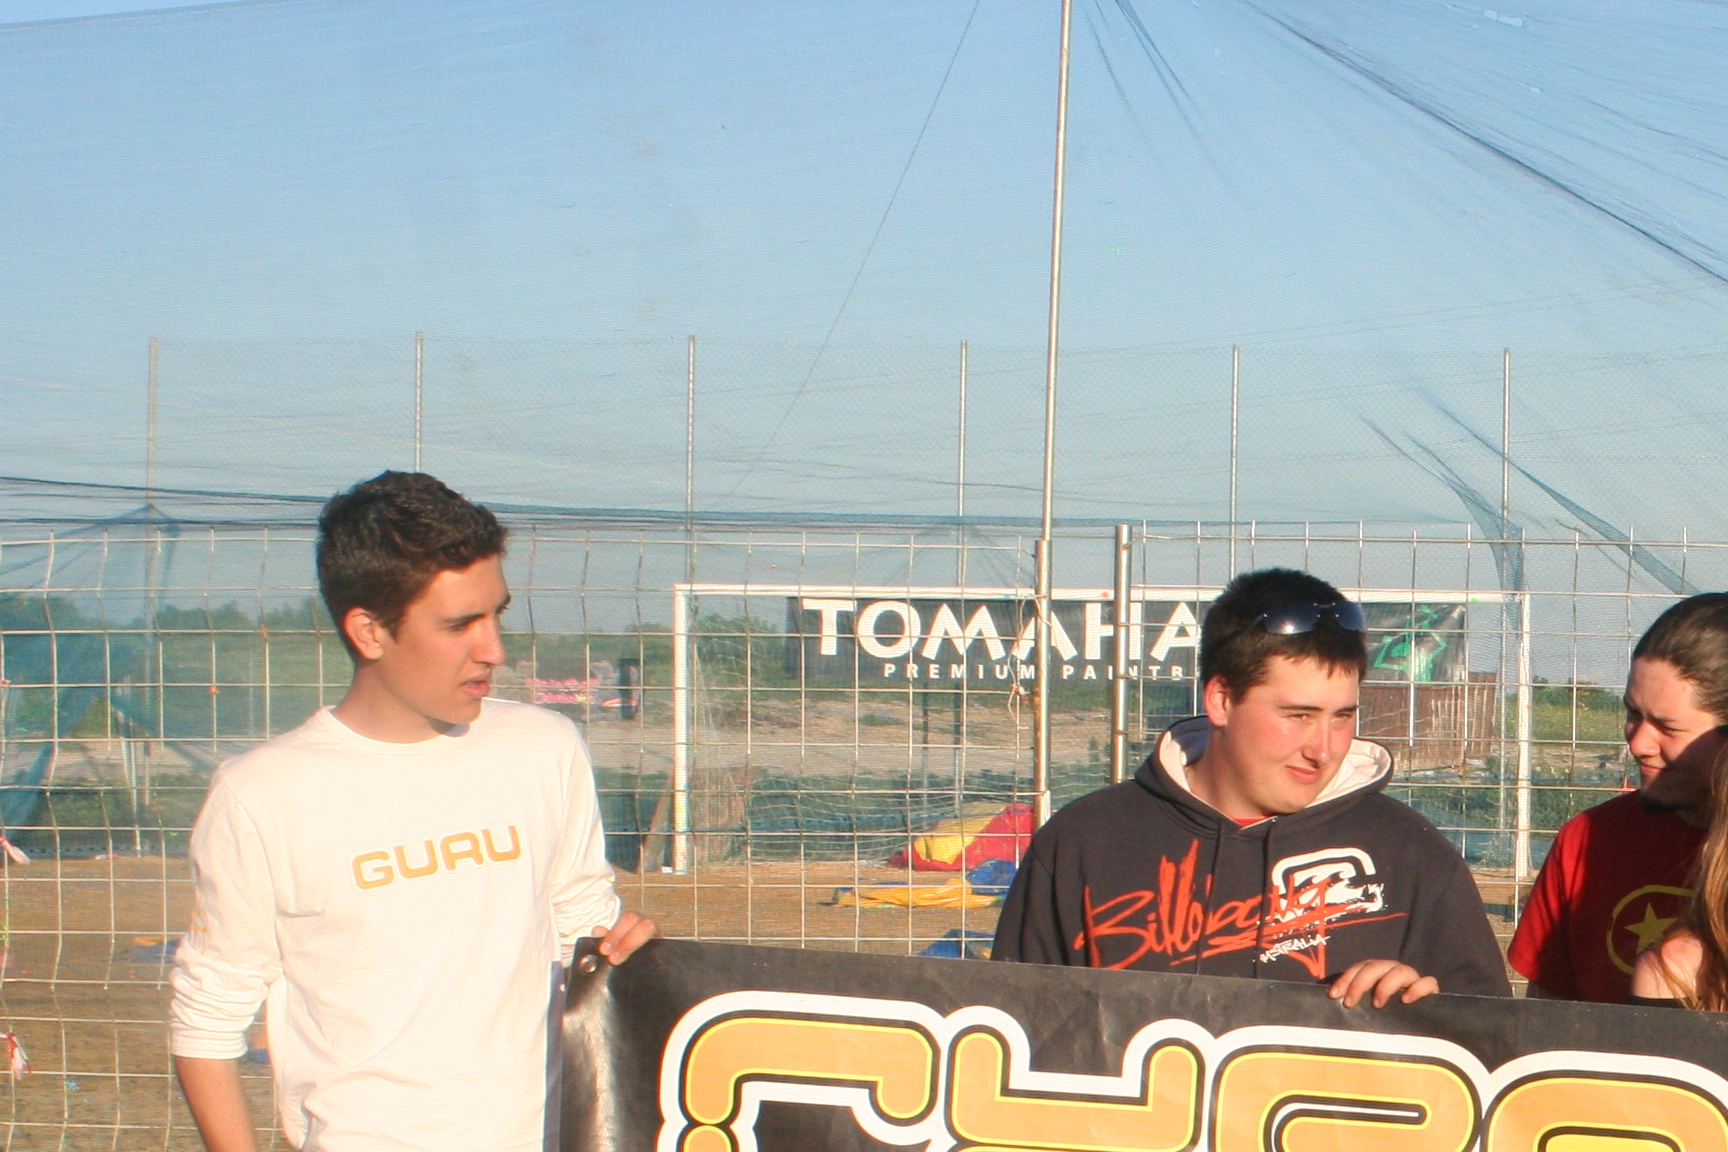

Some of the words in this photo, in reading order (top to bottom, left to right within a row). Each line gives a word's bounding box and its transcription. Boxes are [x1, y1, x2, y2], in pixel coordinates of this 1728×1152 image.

[802, 597, 1201, 661] TOMAHA
[883, 663, 1036, 681] PREMIUM
[1063, 665, 1187, 682] PAINTB
[351, 824, 522, 890] GURU
[1253, 933, 1330, 963] USTRALIA
